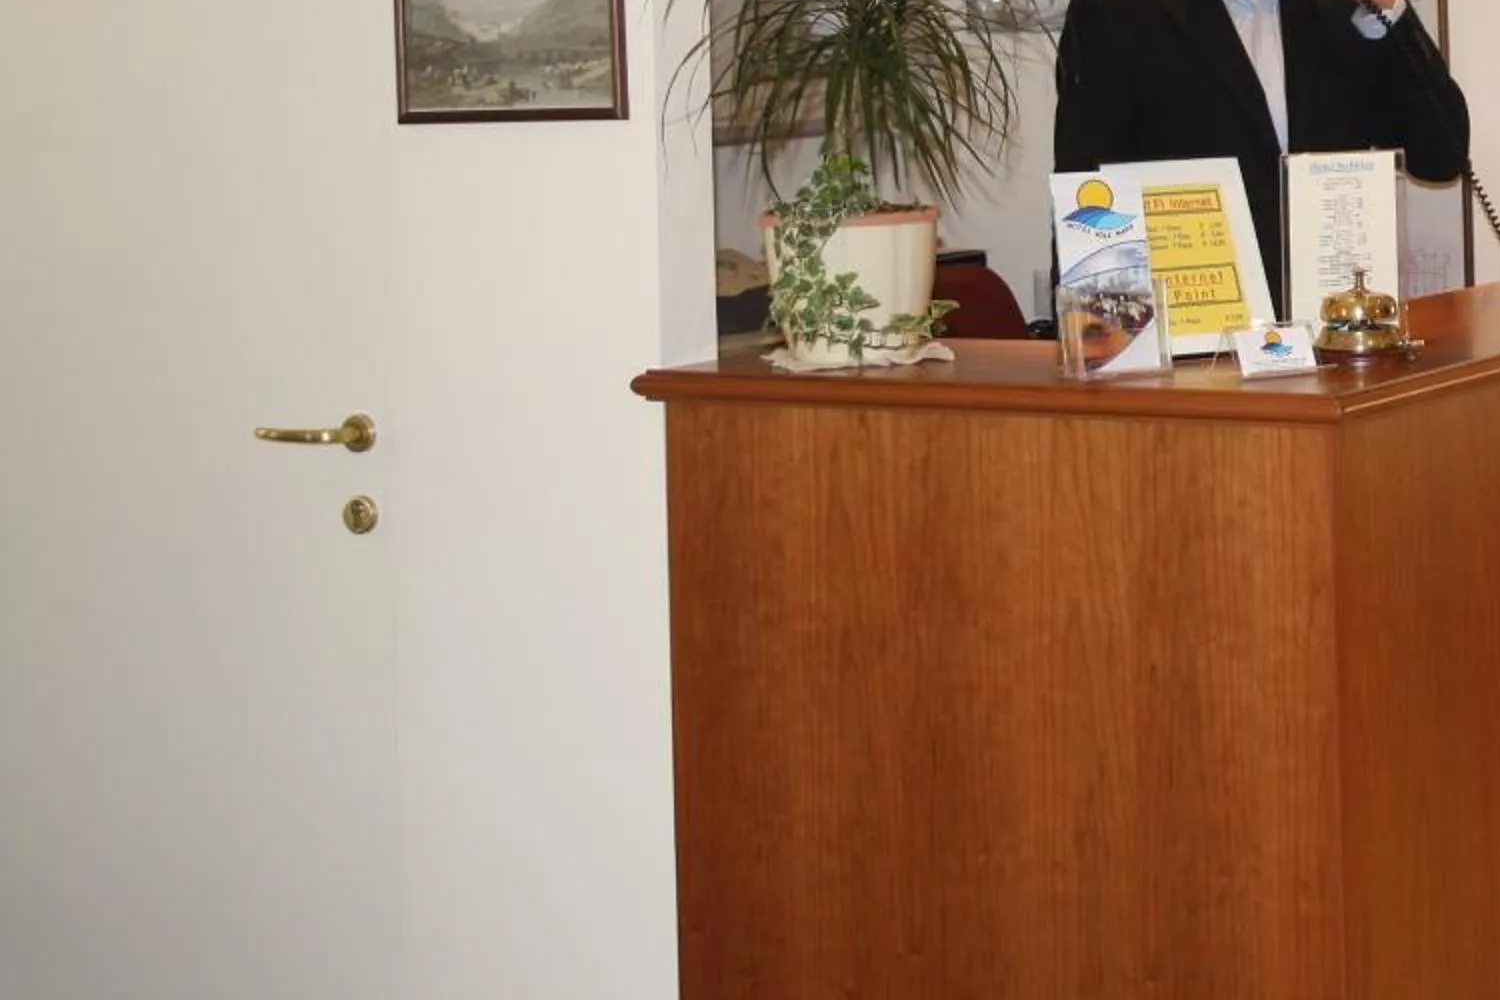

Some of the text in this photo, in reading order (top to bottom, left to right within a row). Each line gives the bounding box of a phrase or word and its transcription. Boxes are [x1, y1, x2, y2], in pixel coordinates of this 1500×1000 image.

[1169, 196, 1213, 209] Internet
[1167, 270, 1224, 287] nternet
[1173, 288, 1217, 302] Point
